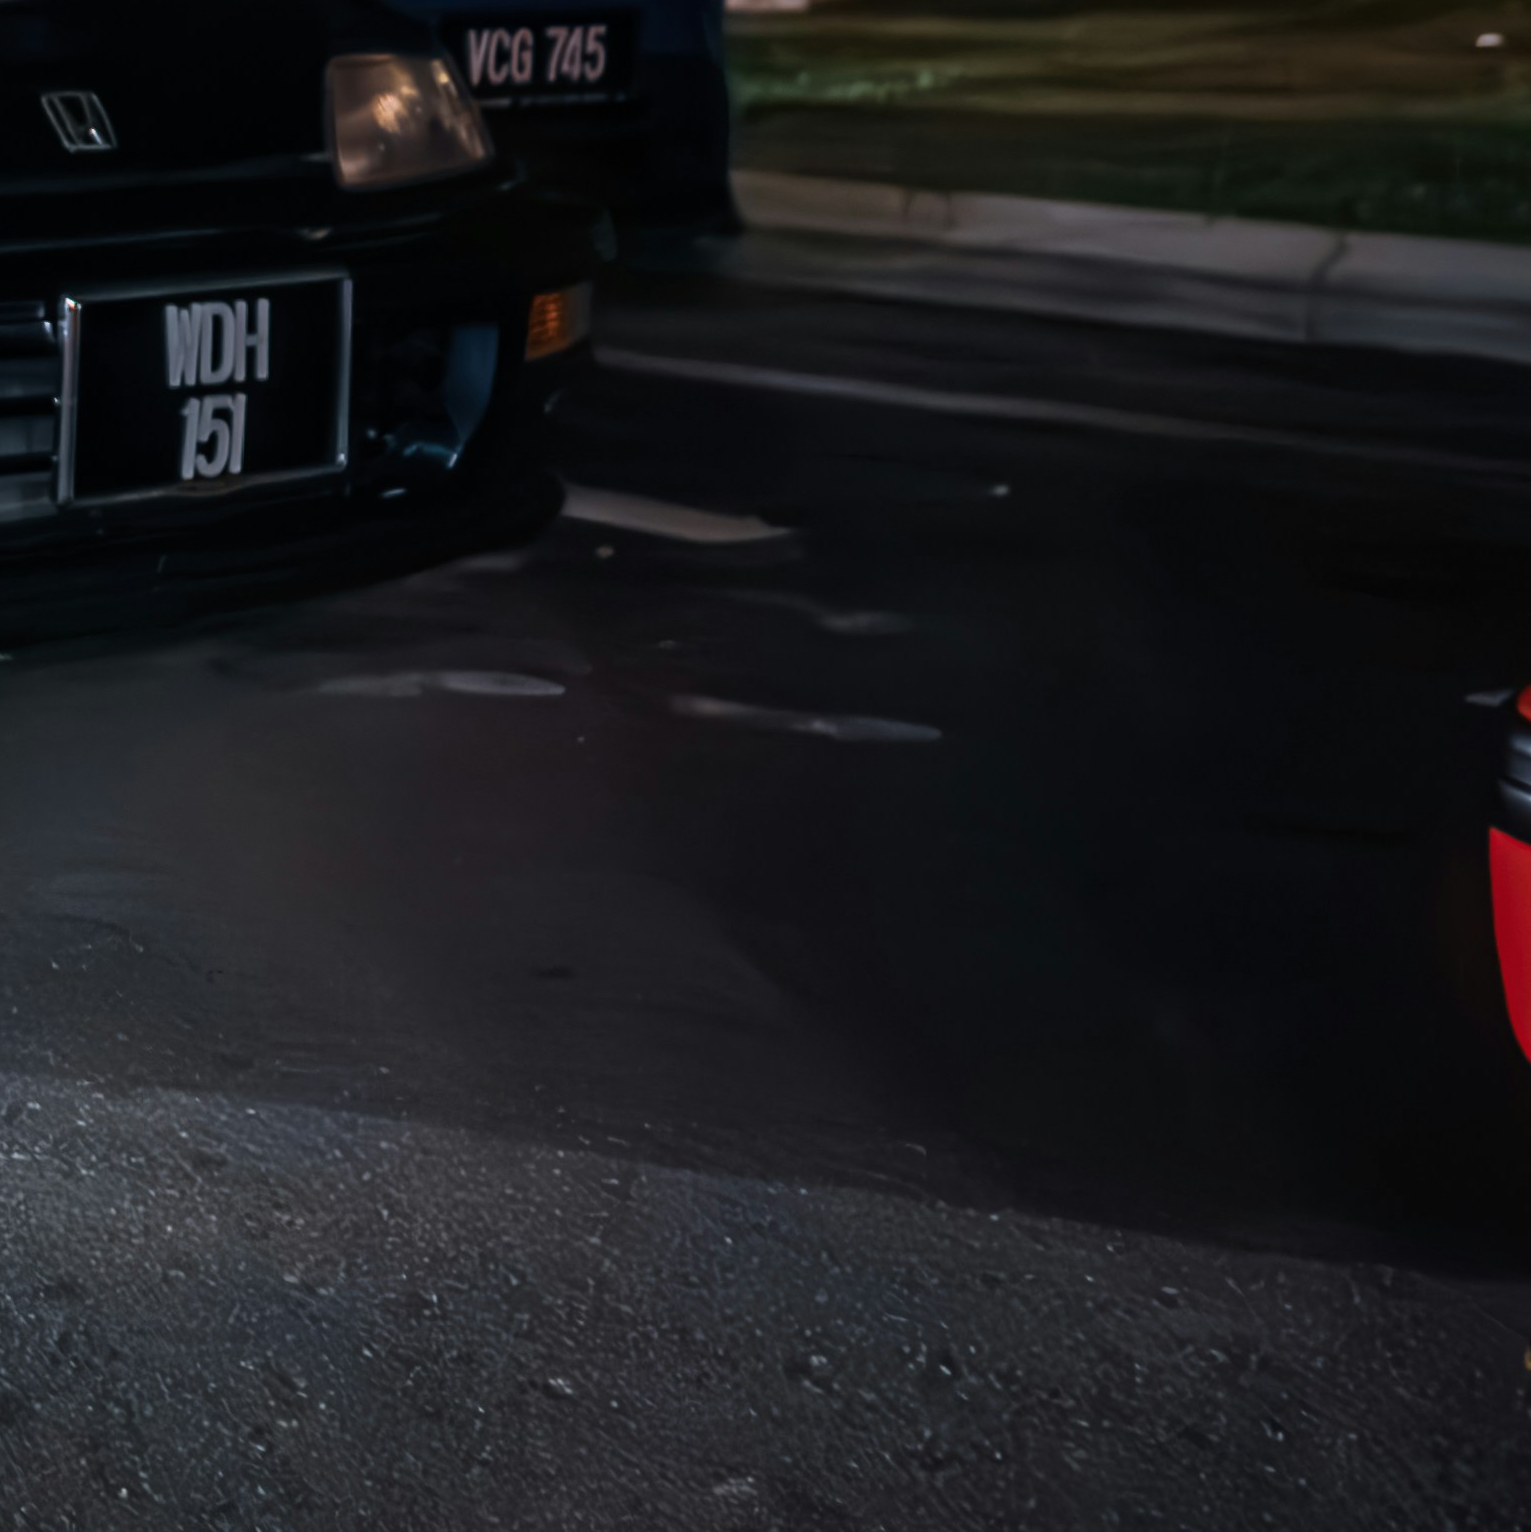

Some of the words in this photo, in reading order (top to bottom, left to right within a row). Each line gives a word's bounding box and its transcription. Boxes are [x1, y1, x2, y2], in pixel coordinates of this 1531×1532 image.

[467, 27, 534, 87] VCG
[545, 23, 608, 84] 745
[165, 297, 271, 389] WDH
[180, 392, 248, 481] 151
